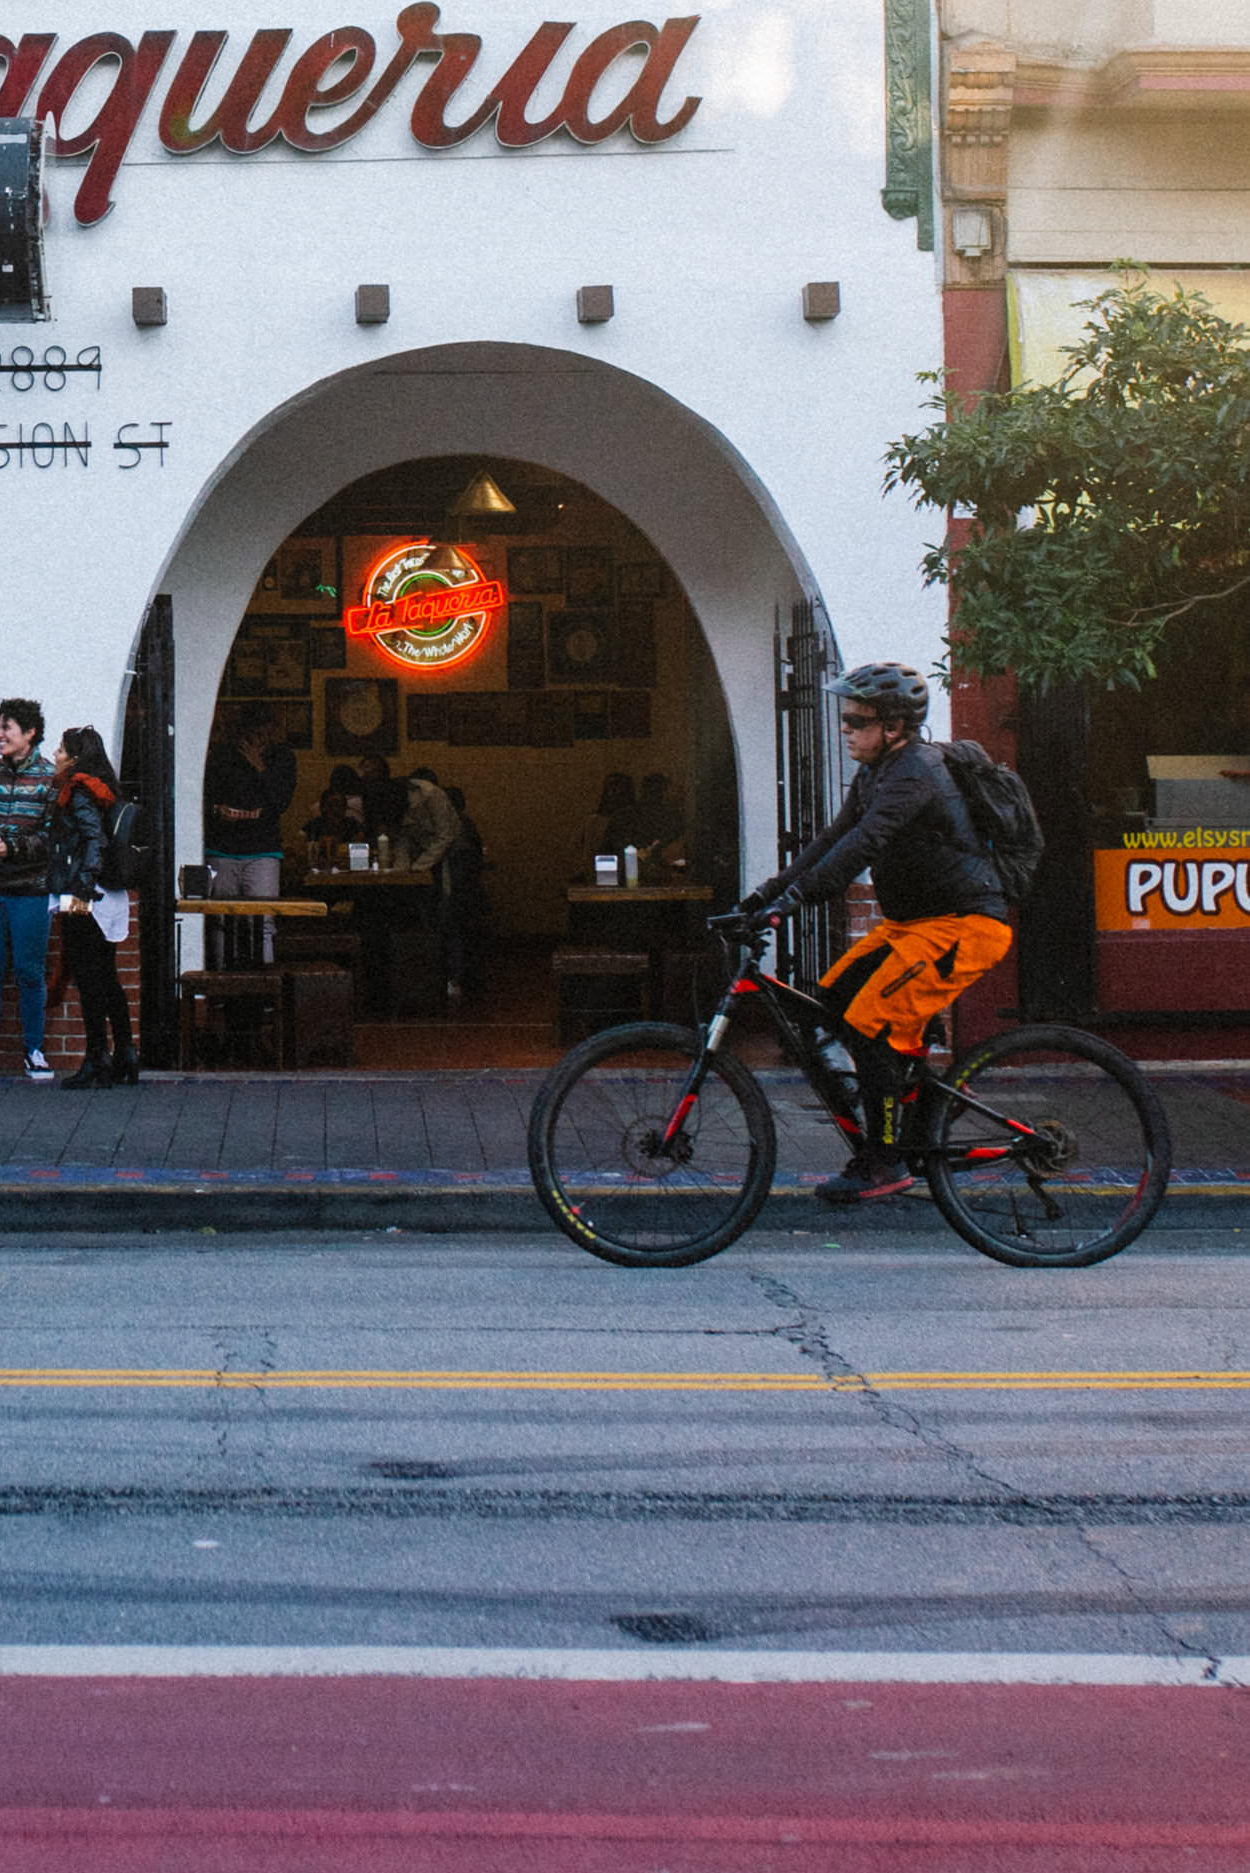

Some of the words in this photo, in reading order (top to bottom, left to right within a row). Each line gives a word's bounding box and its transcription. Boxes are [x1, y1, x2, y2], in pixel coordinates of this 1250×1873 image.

[113, 421, 173, 469] ST
[365, 600, 393, 631] La
[396, 588, 498, 624] Taqueria
